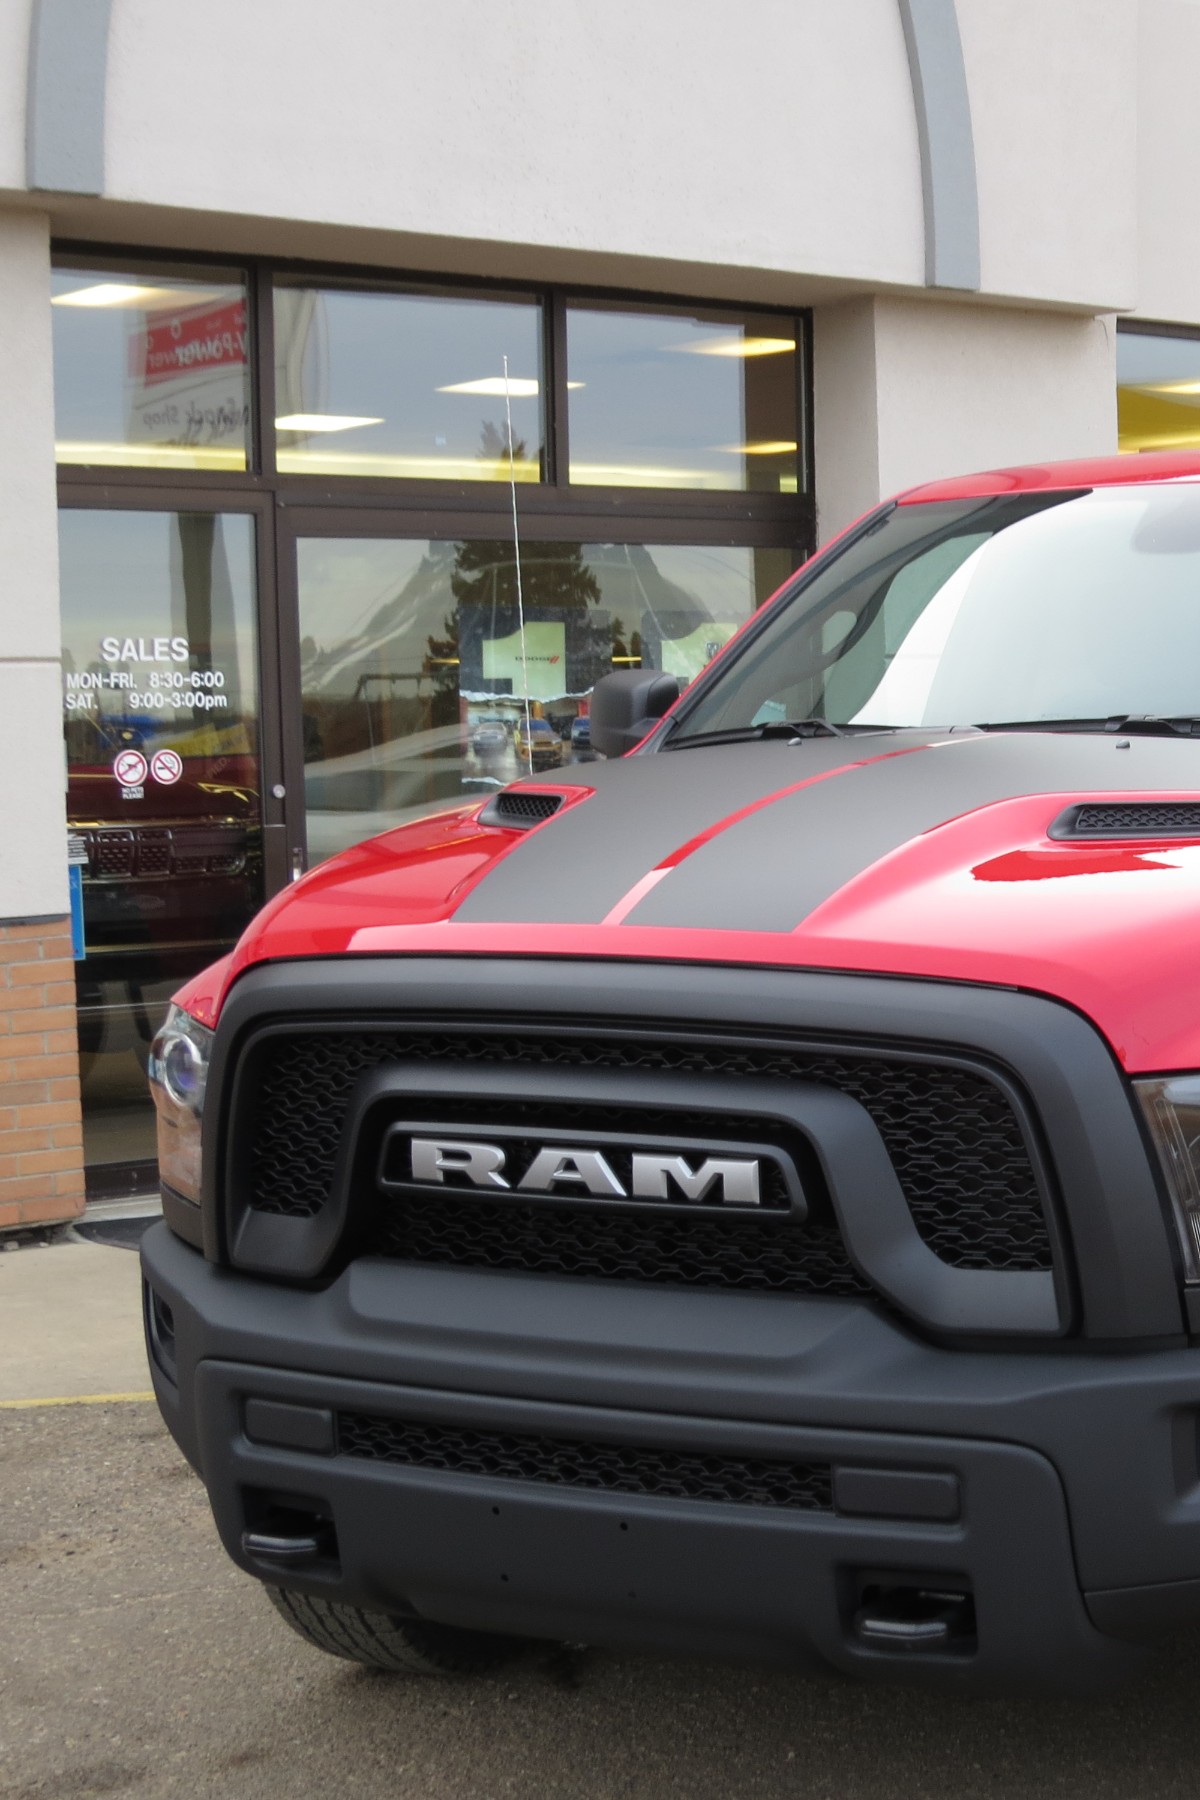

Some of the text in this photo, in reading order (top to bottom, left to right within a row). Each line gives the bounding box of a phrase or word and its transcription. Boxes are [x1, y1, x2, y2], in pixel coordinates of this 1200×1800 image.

[102, 637, 189, 662] SALES
[66, 671, 224, 689] MON-FRI. 8:30-6:00
[66, 691, 228, 711] SAT. 9:00-3:00pm
[411, 1137, 760, 1205] RAM
